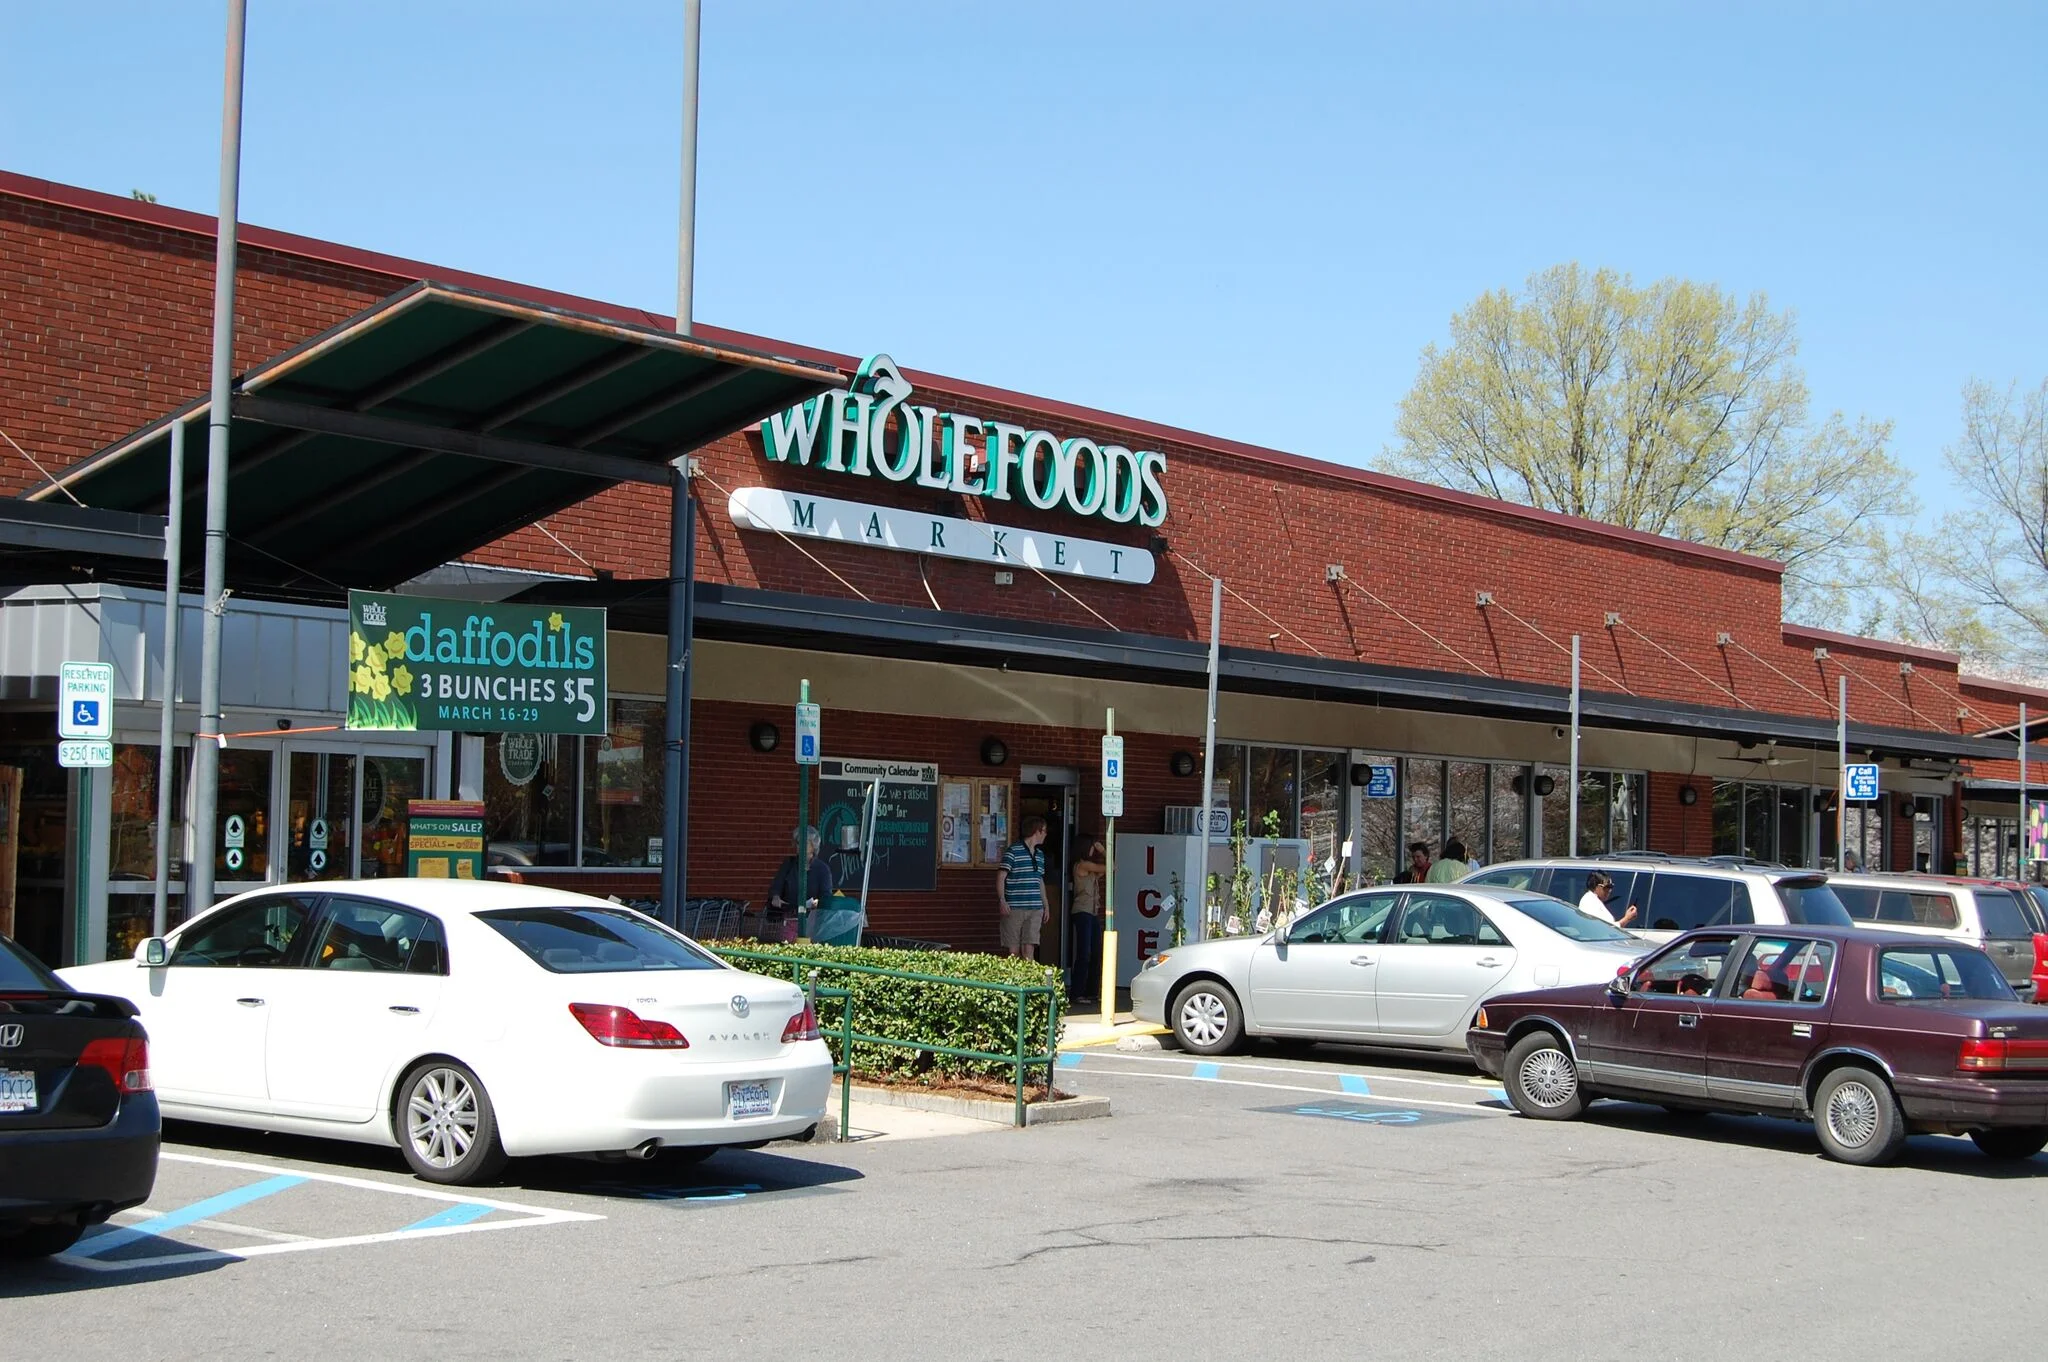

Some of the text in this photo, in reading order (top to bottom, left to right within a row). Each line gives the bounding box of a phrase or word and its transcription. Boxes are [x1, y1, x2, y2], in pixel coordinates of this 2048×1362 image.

[762, 354, 1168, 528] WHOLE FOODS
[792, 499, 1124, 575] MARKET
[363, 602, 387, 613] WHOLE
[363, 612, 386, 621] FOODS
[405, 613, 595, 670] daffodils
[65, 669, 109, 681] RESERVED
[67, 682, 106, 693] PARKING
[421, 673, 596, 723] 3 BUNCHES $5
[439, 705, 539, 721] MARCH 16-29
[62, 745, 110, 761] $250 FINE
[844, 763, 887, 778] Community
[888, 765, 919, 777] Calendar
[1858, 767, 1872, 775] Call
[452, 822, 483, 833] SALE?
[1137, 845, 1162, 961] ICE
[709, 1032, 771, 1041] AVALON
[0, 1079, 33, 1100] CKI2
